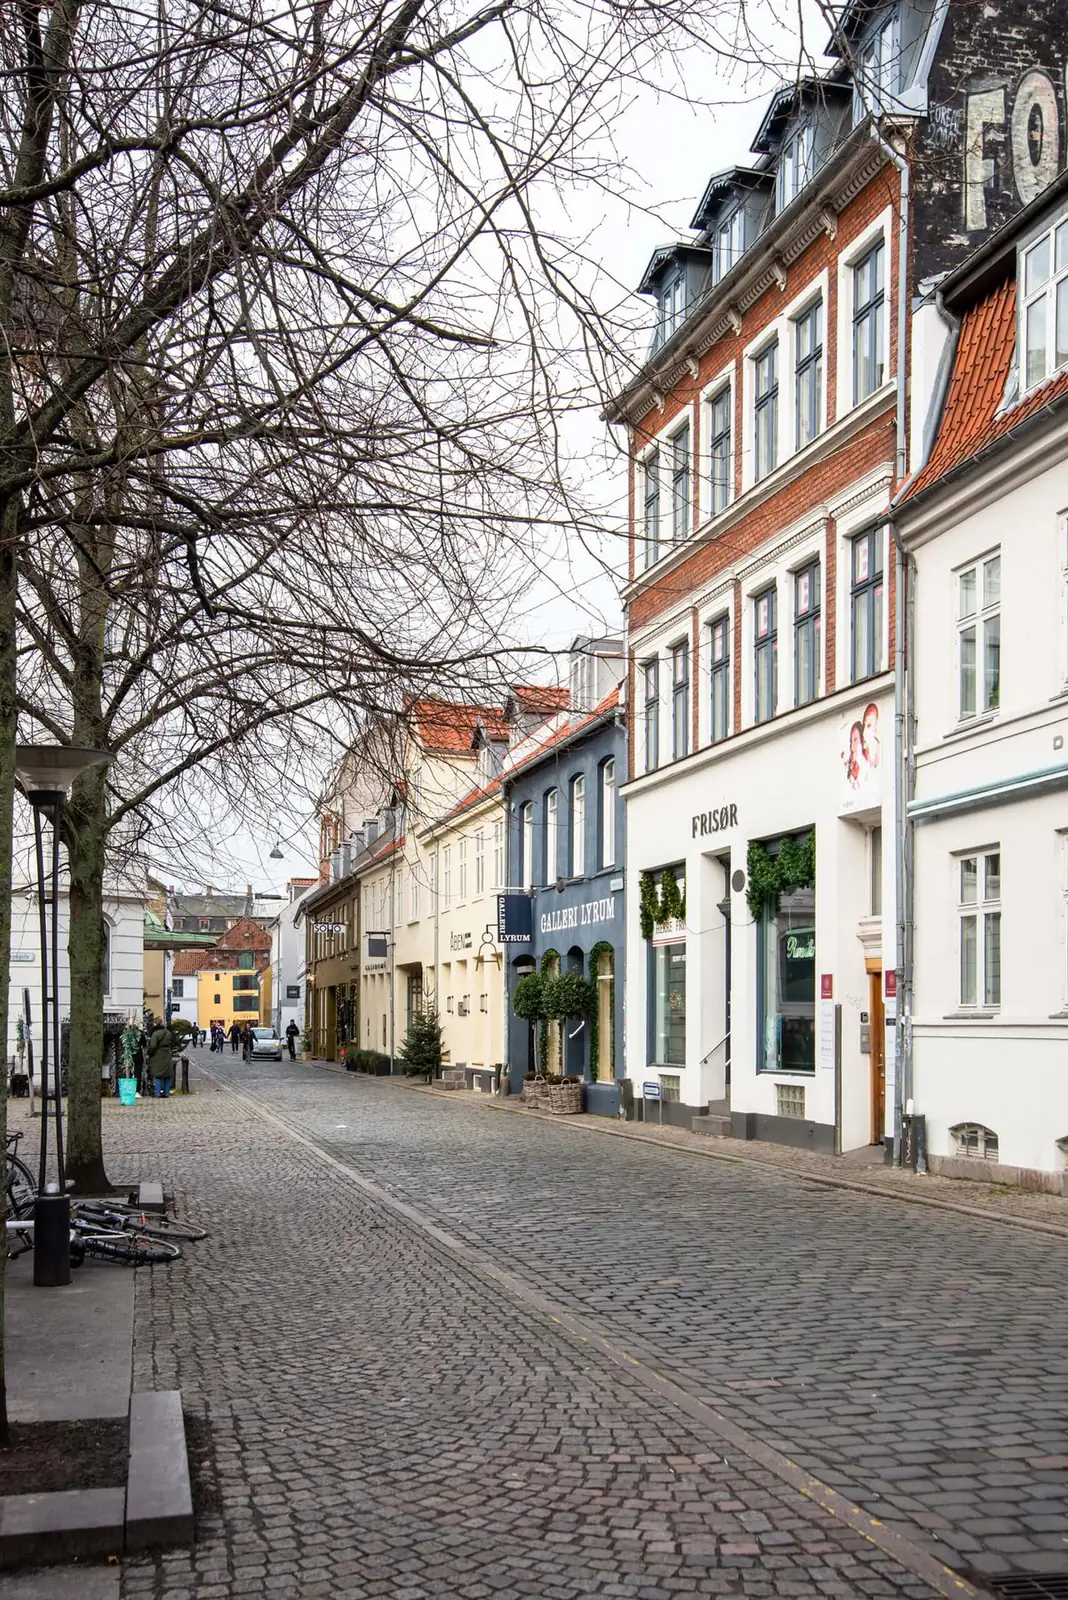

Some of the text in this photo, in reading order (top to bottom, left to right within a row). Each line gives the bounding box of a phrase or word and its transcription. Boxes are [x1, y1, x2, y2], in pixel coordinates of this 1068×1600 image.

[692, 803, 738, 839] FRISØR
[540, 897, 615, 933] GALLERI LYRUM
[314, 924, 342, 934] SOHO
[500, 934, 530, 942] LYRUM
